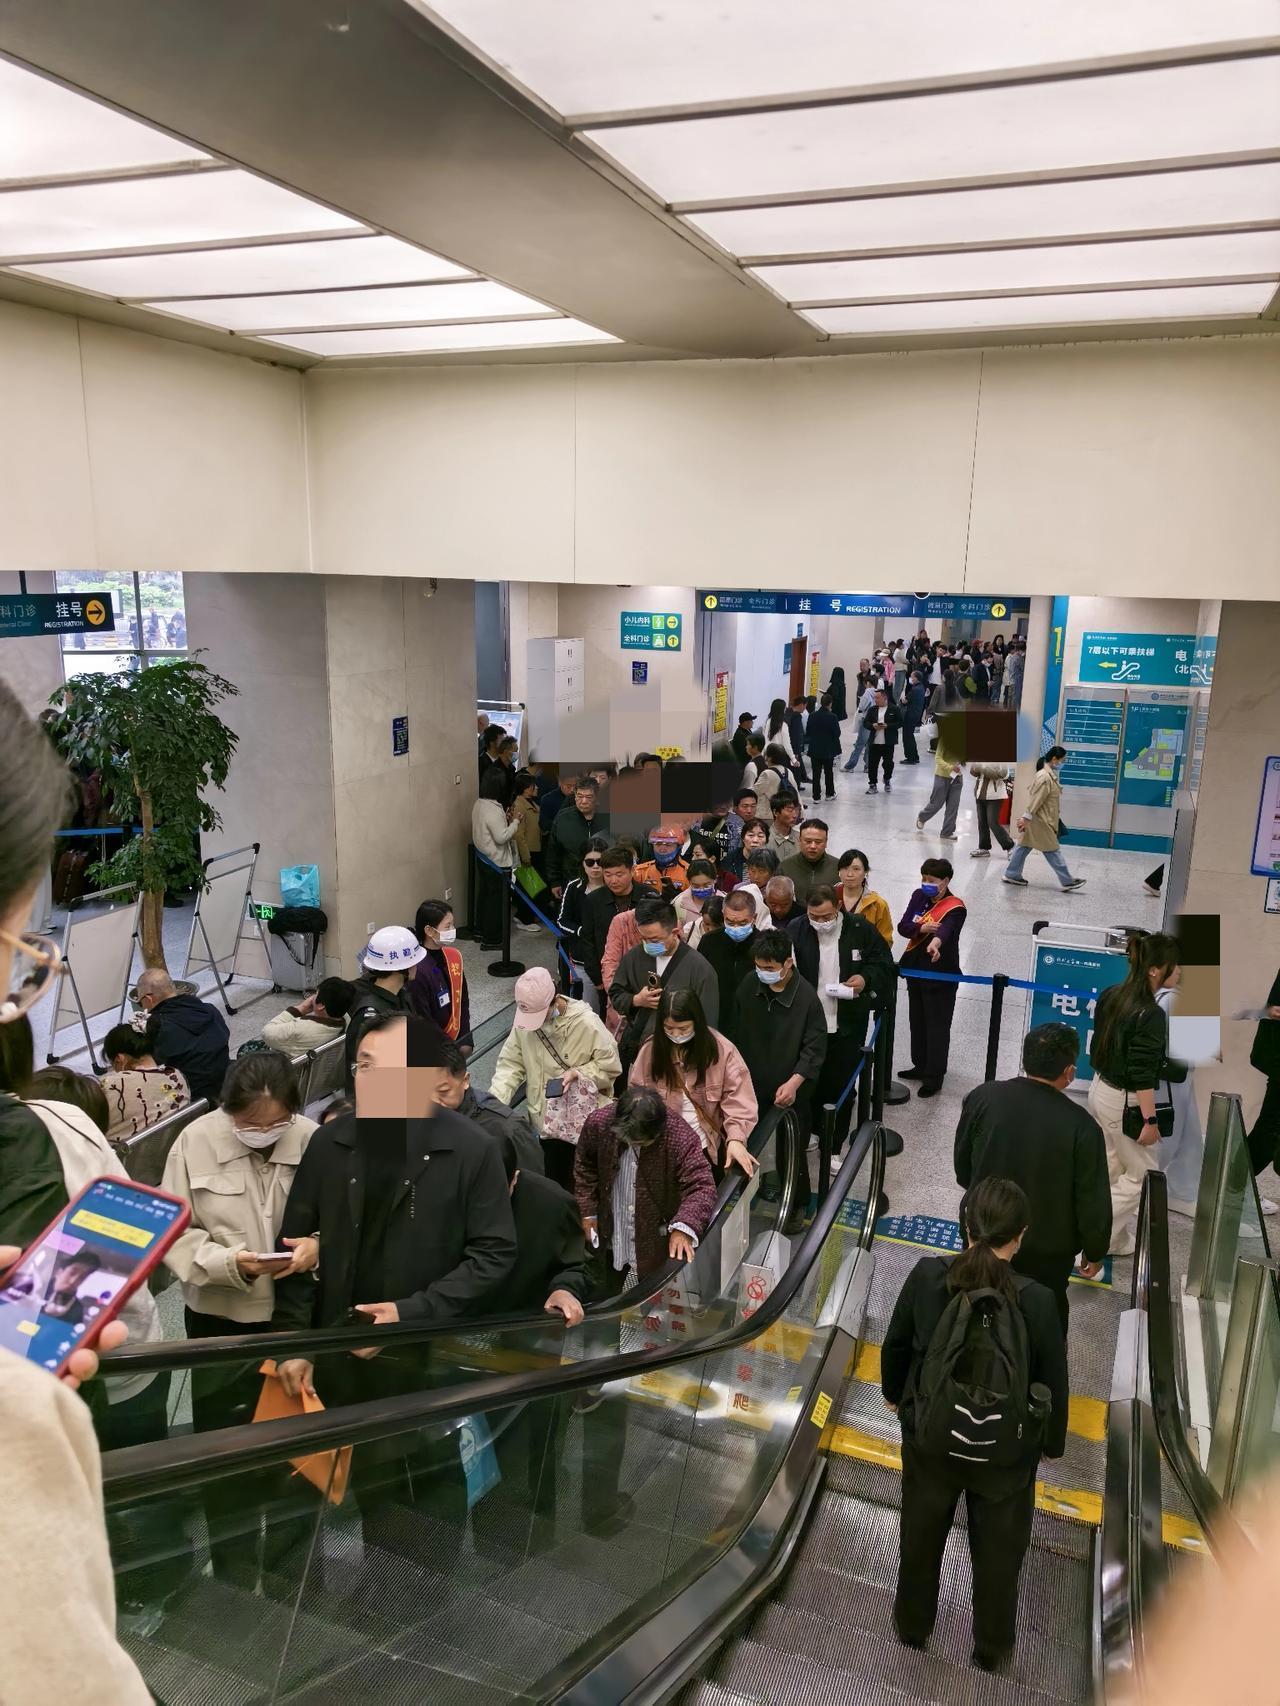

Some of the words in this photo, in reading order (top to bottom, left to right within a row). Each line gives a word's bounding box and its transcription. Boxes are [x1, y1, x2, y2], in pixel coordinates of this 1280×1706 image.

[56, 601, 83, 618] 挂号
[799, 598, 842, 612] 挂号
[846, 605, 900, 614] REGISTRATION
[44, 620, 83, 628] REGISTRATION
[624, 615, 650, 625] 小儿内科
[624, 634, 650, 643] 全科门诊
[1054, 627, 1062, 657] 1
[1087, 646, 1155, 657] 7层以下可乘扶梯
[389, 948, 411, 960] 执勤
